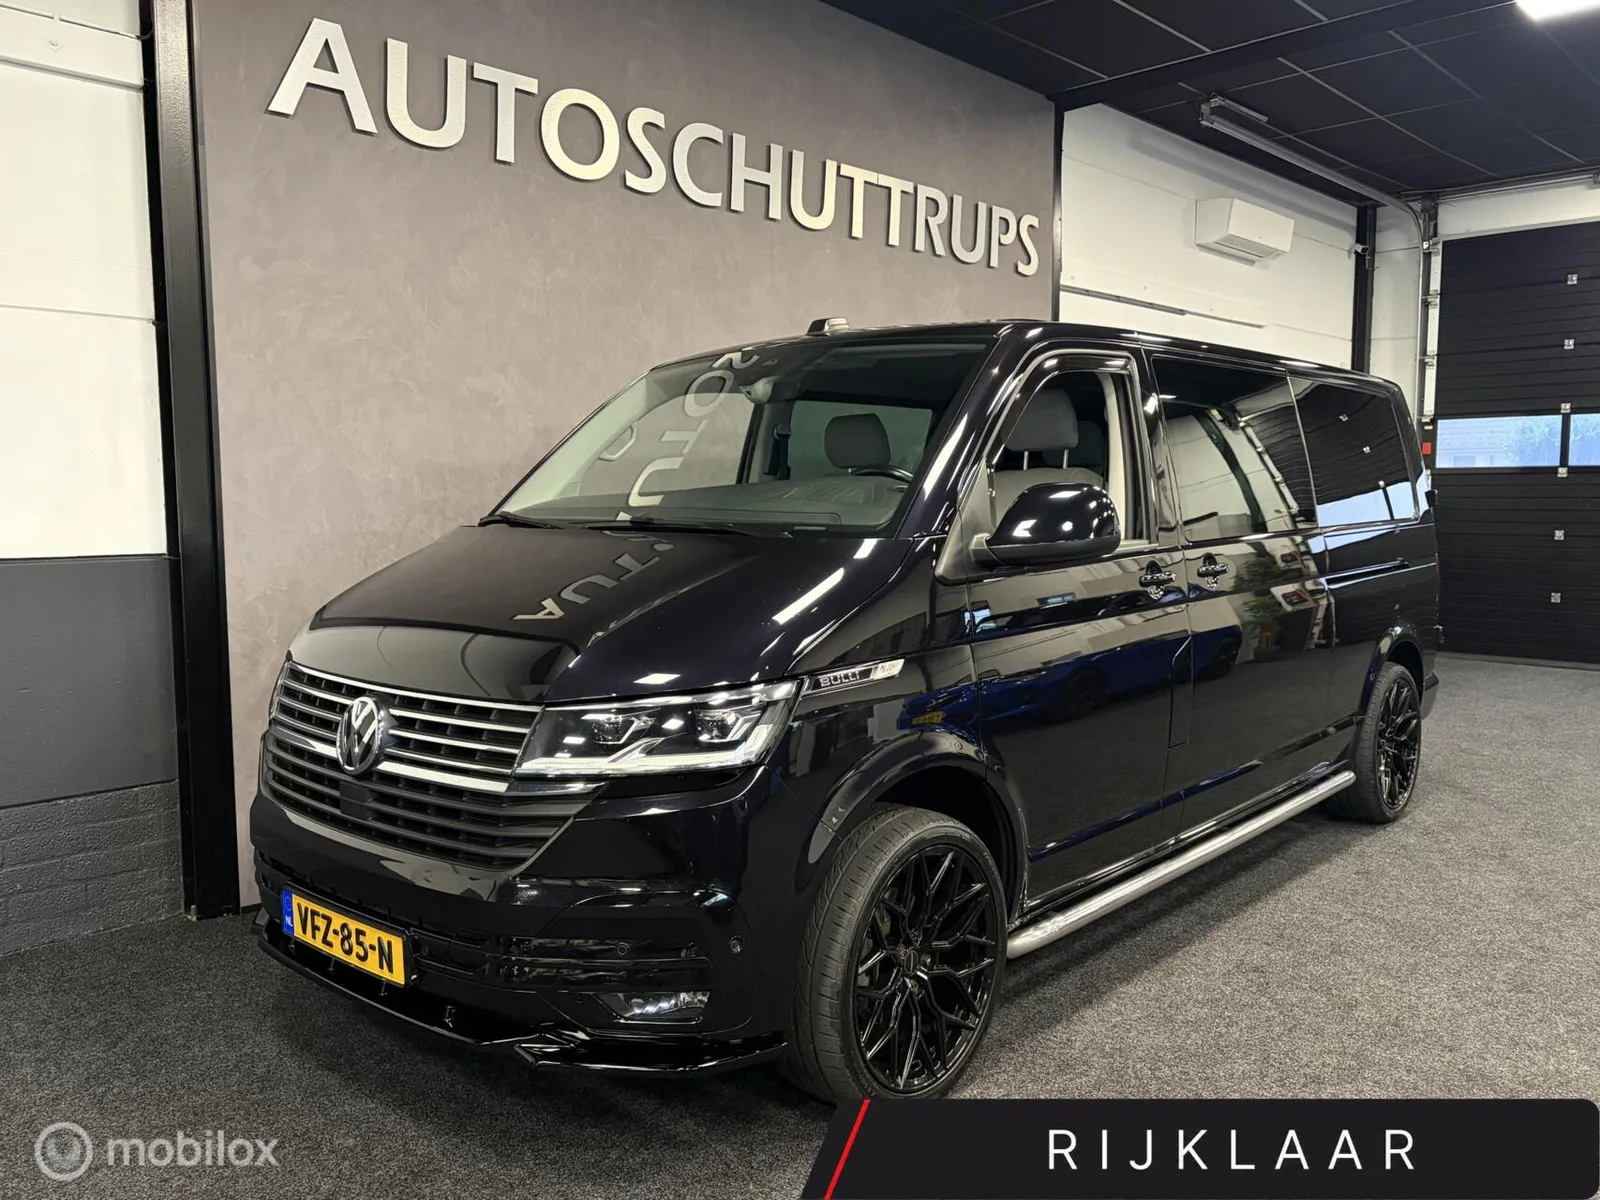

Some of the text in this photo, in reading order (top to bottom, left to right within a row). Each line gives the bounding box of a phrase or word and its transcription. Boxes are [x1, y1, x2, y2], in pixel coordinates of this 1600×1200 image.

[266, 17, 1041, 277] AUTOSCHUTTRUPS
[285, 915, 293, 927] NL
[296, 901, 395, 974] VFZ-85-N
